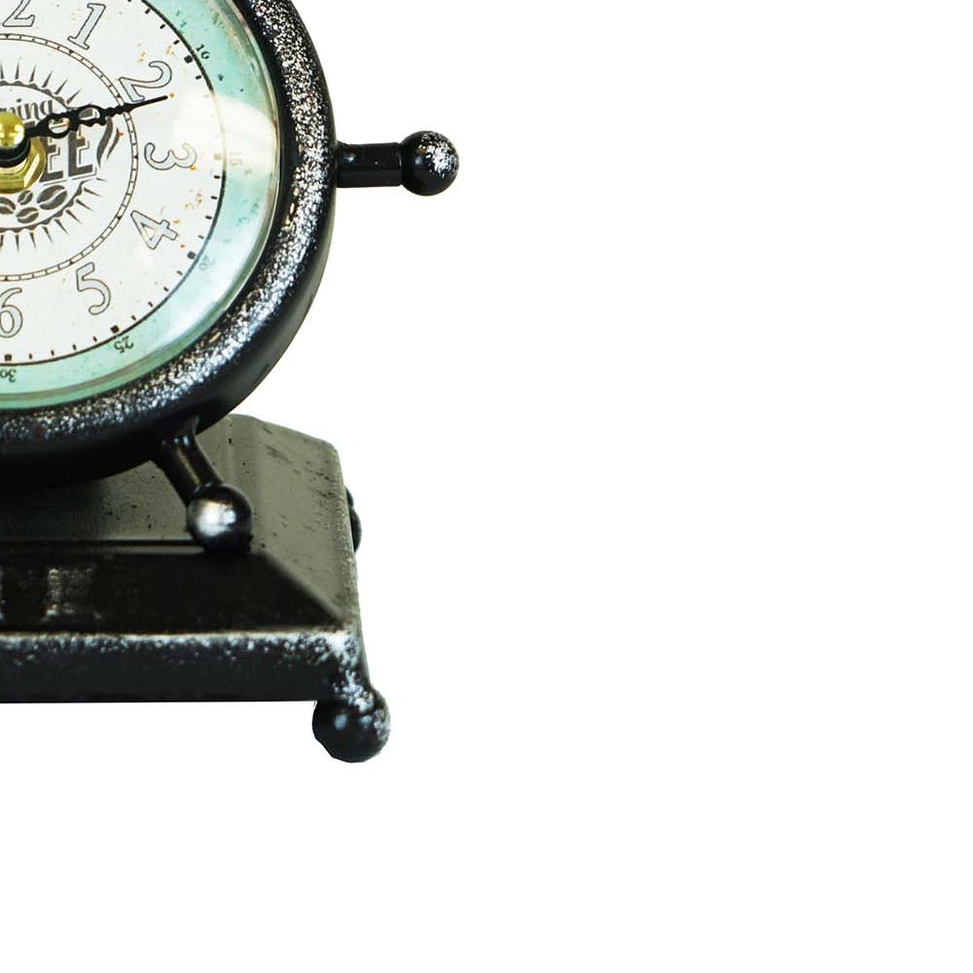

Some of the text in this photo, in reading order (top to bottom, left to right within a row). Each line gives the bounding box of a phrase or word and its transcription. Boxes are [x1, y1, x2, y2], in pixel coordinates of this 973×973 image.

[67, 2, 107, 51] 1
[195, 43, 211, 60] 10
[118, 60, 173, 104] 2
[143, 141, 198, 171] 3
[130, 209, 179, 250] 4
[76, 261, 112, 316] 5
[113, 335, 135, 354] 25
[0, 368, 18, 383] 30
